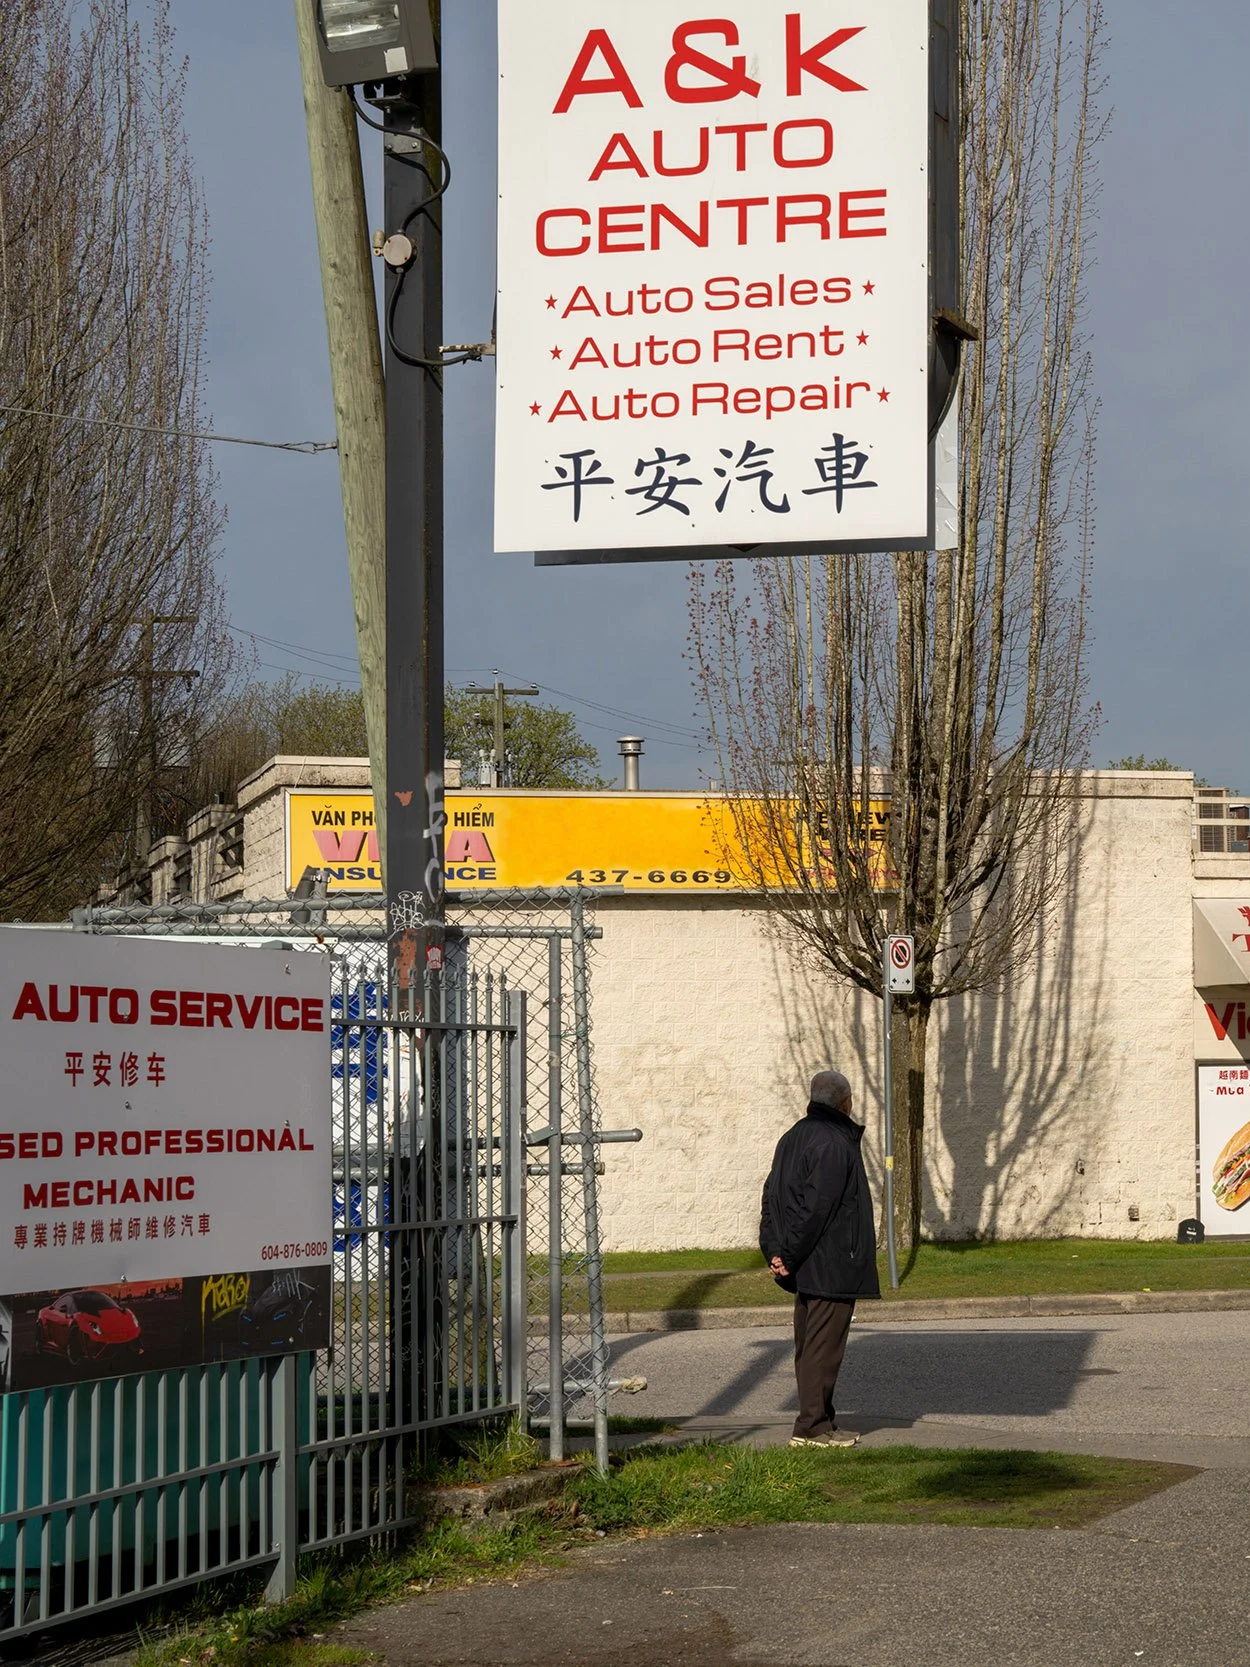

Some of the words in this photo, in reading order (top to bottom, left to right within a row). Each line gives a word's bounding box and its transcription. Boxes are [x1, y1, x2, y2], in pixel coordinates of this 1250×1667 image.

[588, 118, 834, 181] AUTO
[536, 189, 887, 257] CENTRE
[561, 284, 694, 319] Auto
[704, 273, 851, 312] Sales
[569, 335, 701, 370] Auto
[713, 325, 844, 363] Rent
[548, 388, 680, 423] Auto
[692, 376, 871, 420] Repair
[541, 432, 878, 522] 平安汽車
[312, 804, 345, 826] VĂN
[565, 870, 731, 884] 437-6669
[13, 982, 139, 1024] AUTO
[150, 989, 324, 1032] SERVICE
[65, 1051, 166, 1087] 平安修车
[75, 1128, 314, 1156] PROFESSIONAL
[24, 1176, 194, 1209] MECHANIC
[261, 1241, 328, 1260] 604-876-0809
